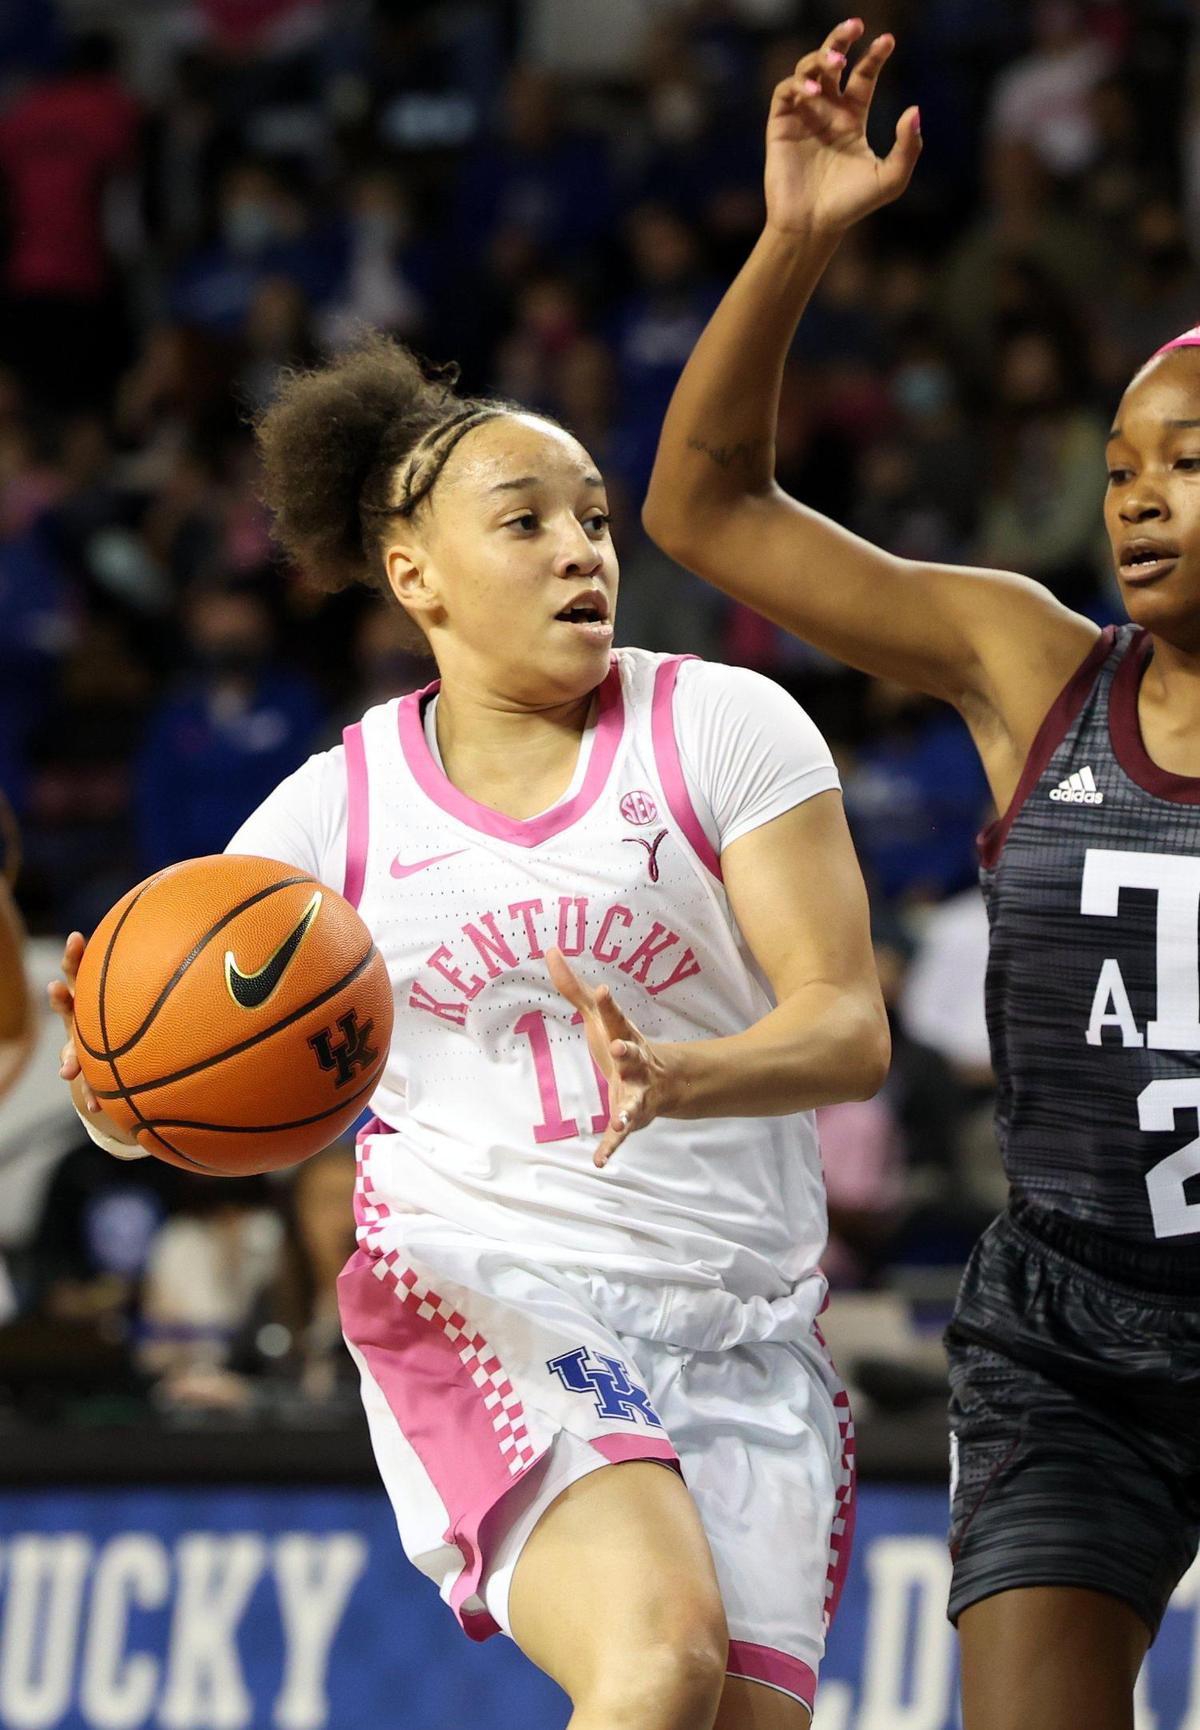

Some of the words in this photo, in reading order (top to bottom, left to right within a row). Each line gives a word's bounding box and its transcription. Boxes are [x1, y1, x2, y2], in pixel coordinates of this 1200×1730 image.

[1049, 788, 1103, 804] adidas
[408, 896, 701, 1026] KENTUCKY
[307, 1008, 379, 1090] UK
[546, 1345, 664, 1429] UK
[0, 1532, 366, 1730] UCKY
